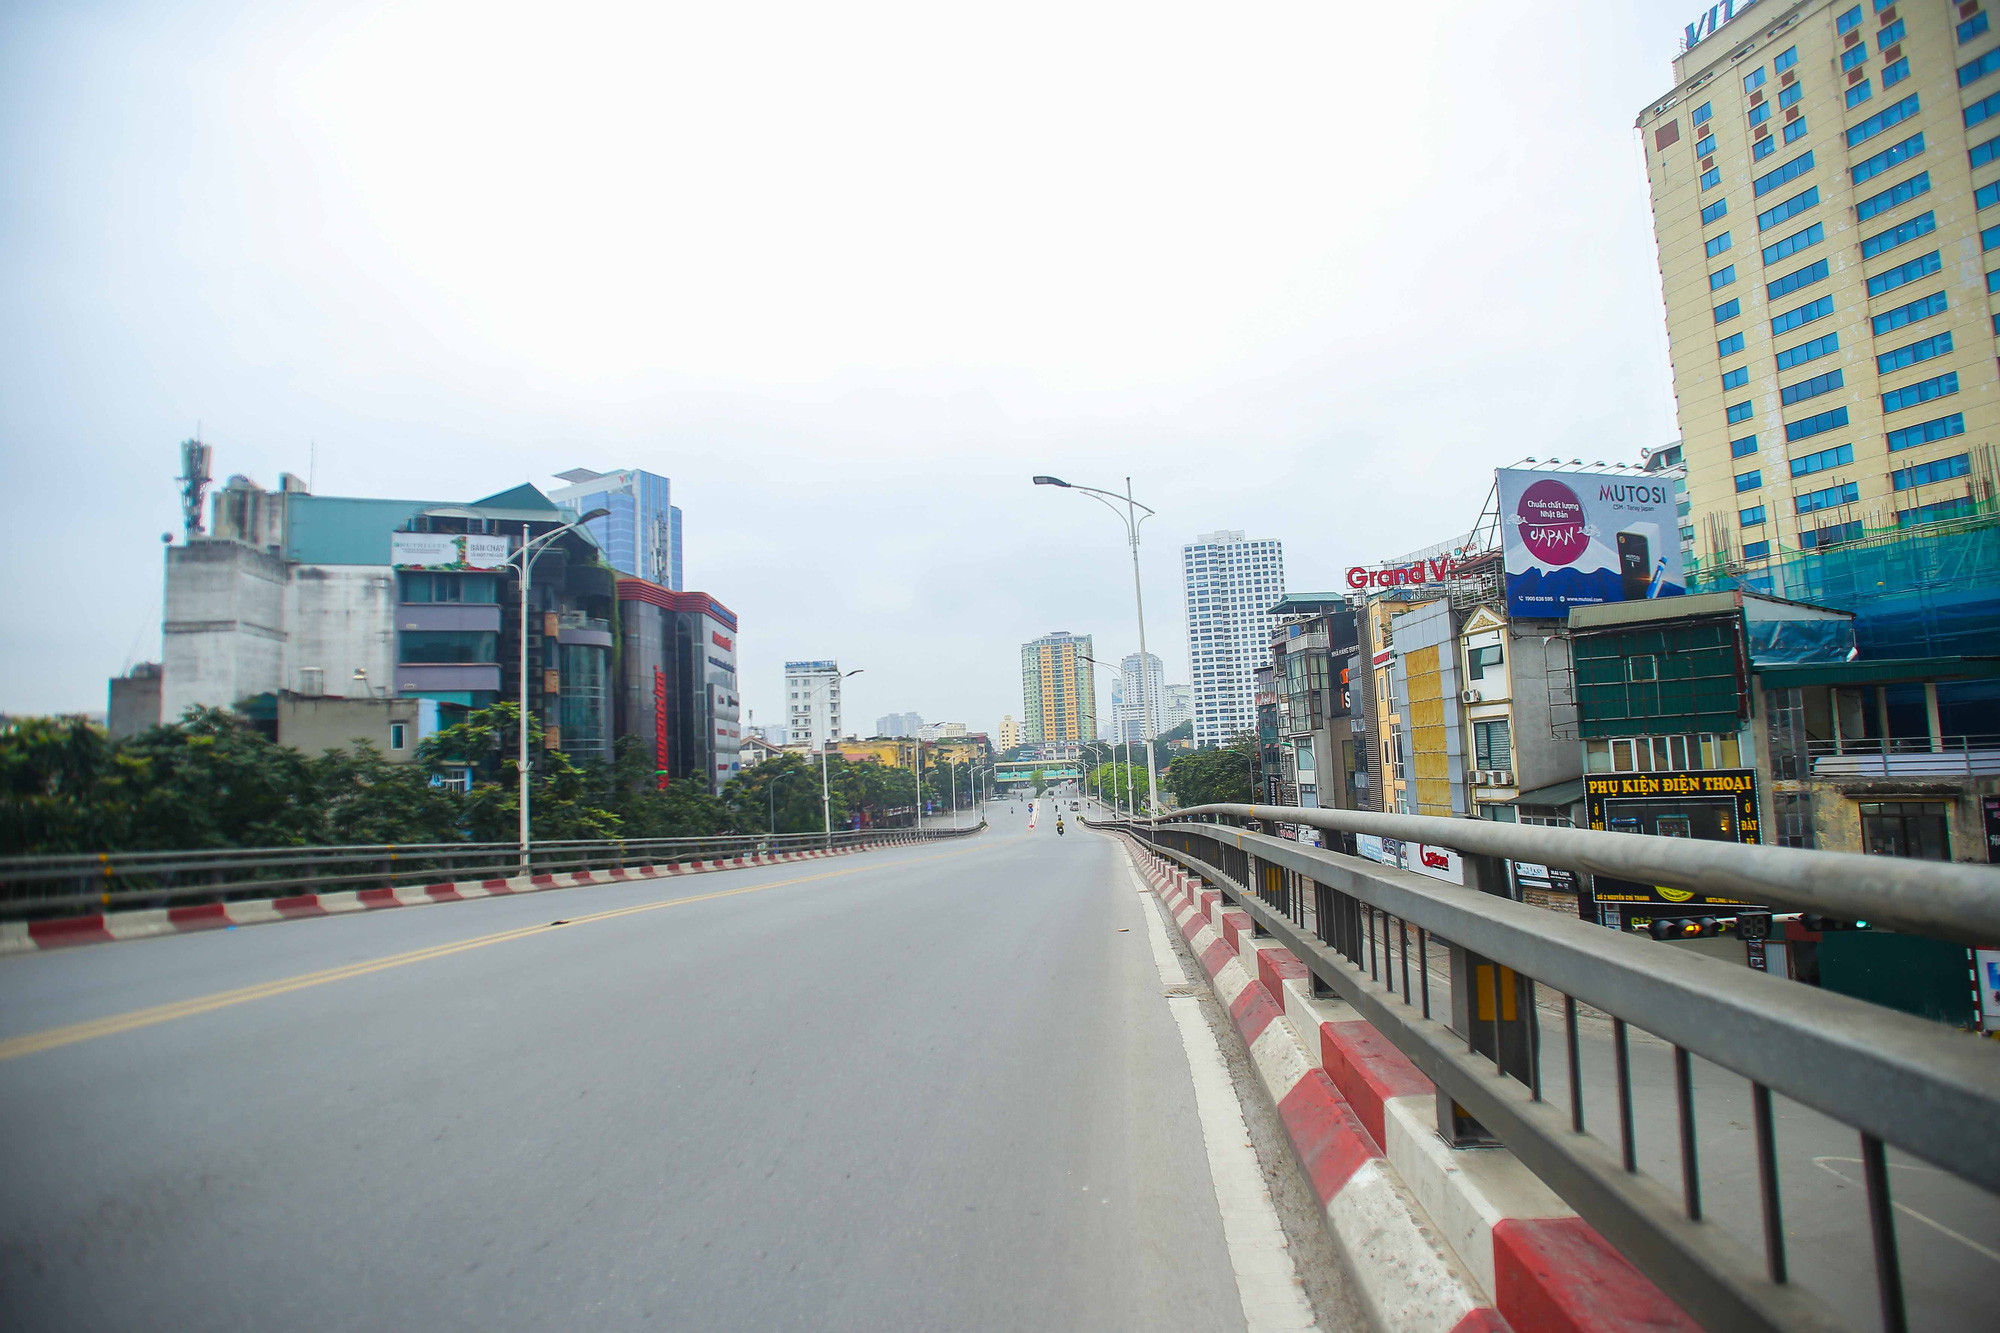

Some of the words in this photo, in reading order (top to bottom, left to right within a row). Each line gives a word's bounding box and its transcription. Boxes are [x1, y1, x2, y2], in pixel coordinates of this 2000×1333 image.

[1599, 484, 1667, 504] MUTOSI
[1530, 526, 1576, 549] JAPAN
[1347, 561, 1426, 589] Grand
[1588, 780, 1618, 797] PHỤ
[1622, 775, 1660, 796] KIỆN
[1662, 774, 1700, 795] ĐIỆN
[1703, 775, 1752, 794] THOẠI
